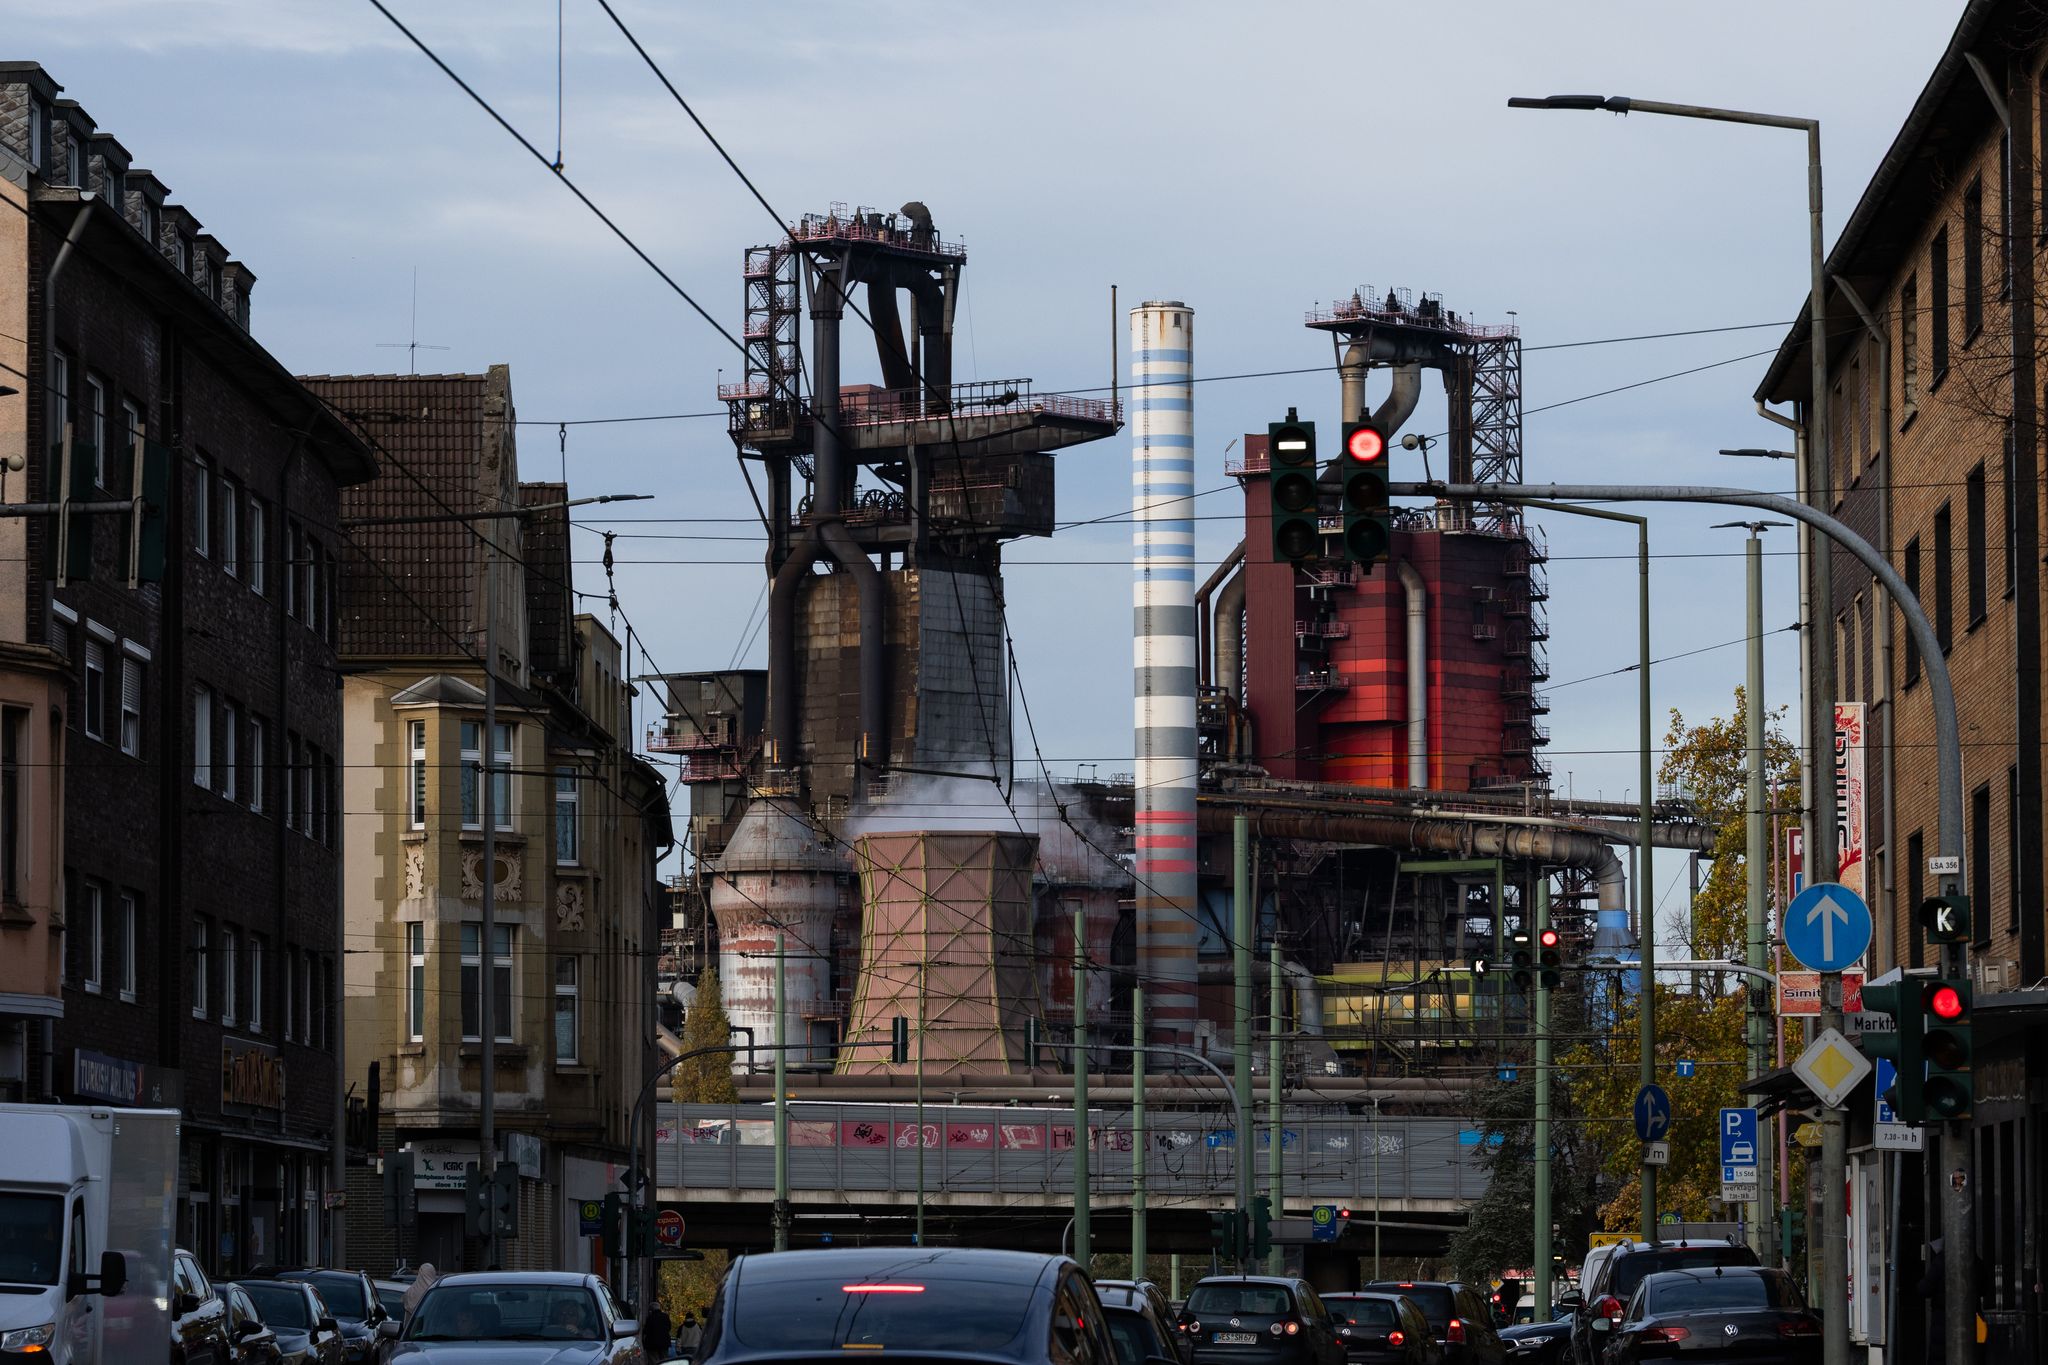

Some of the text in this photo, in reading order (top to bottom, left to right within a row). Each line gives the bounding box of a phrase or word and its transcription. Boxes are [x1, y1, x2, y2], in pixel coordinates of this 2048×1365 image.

[1930, 861, 1958, 870] LSA 356
[1936, 906, 1954, 932] K
[1475, 960, 1484, 973] K
[80, 1058, 110, 1093] TURKISH
[1726, 1112, 1742, 1135] P
